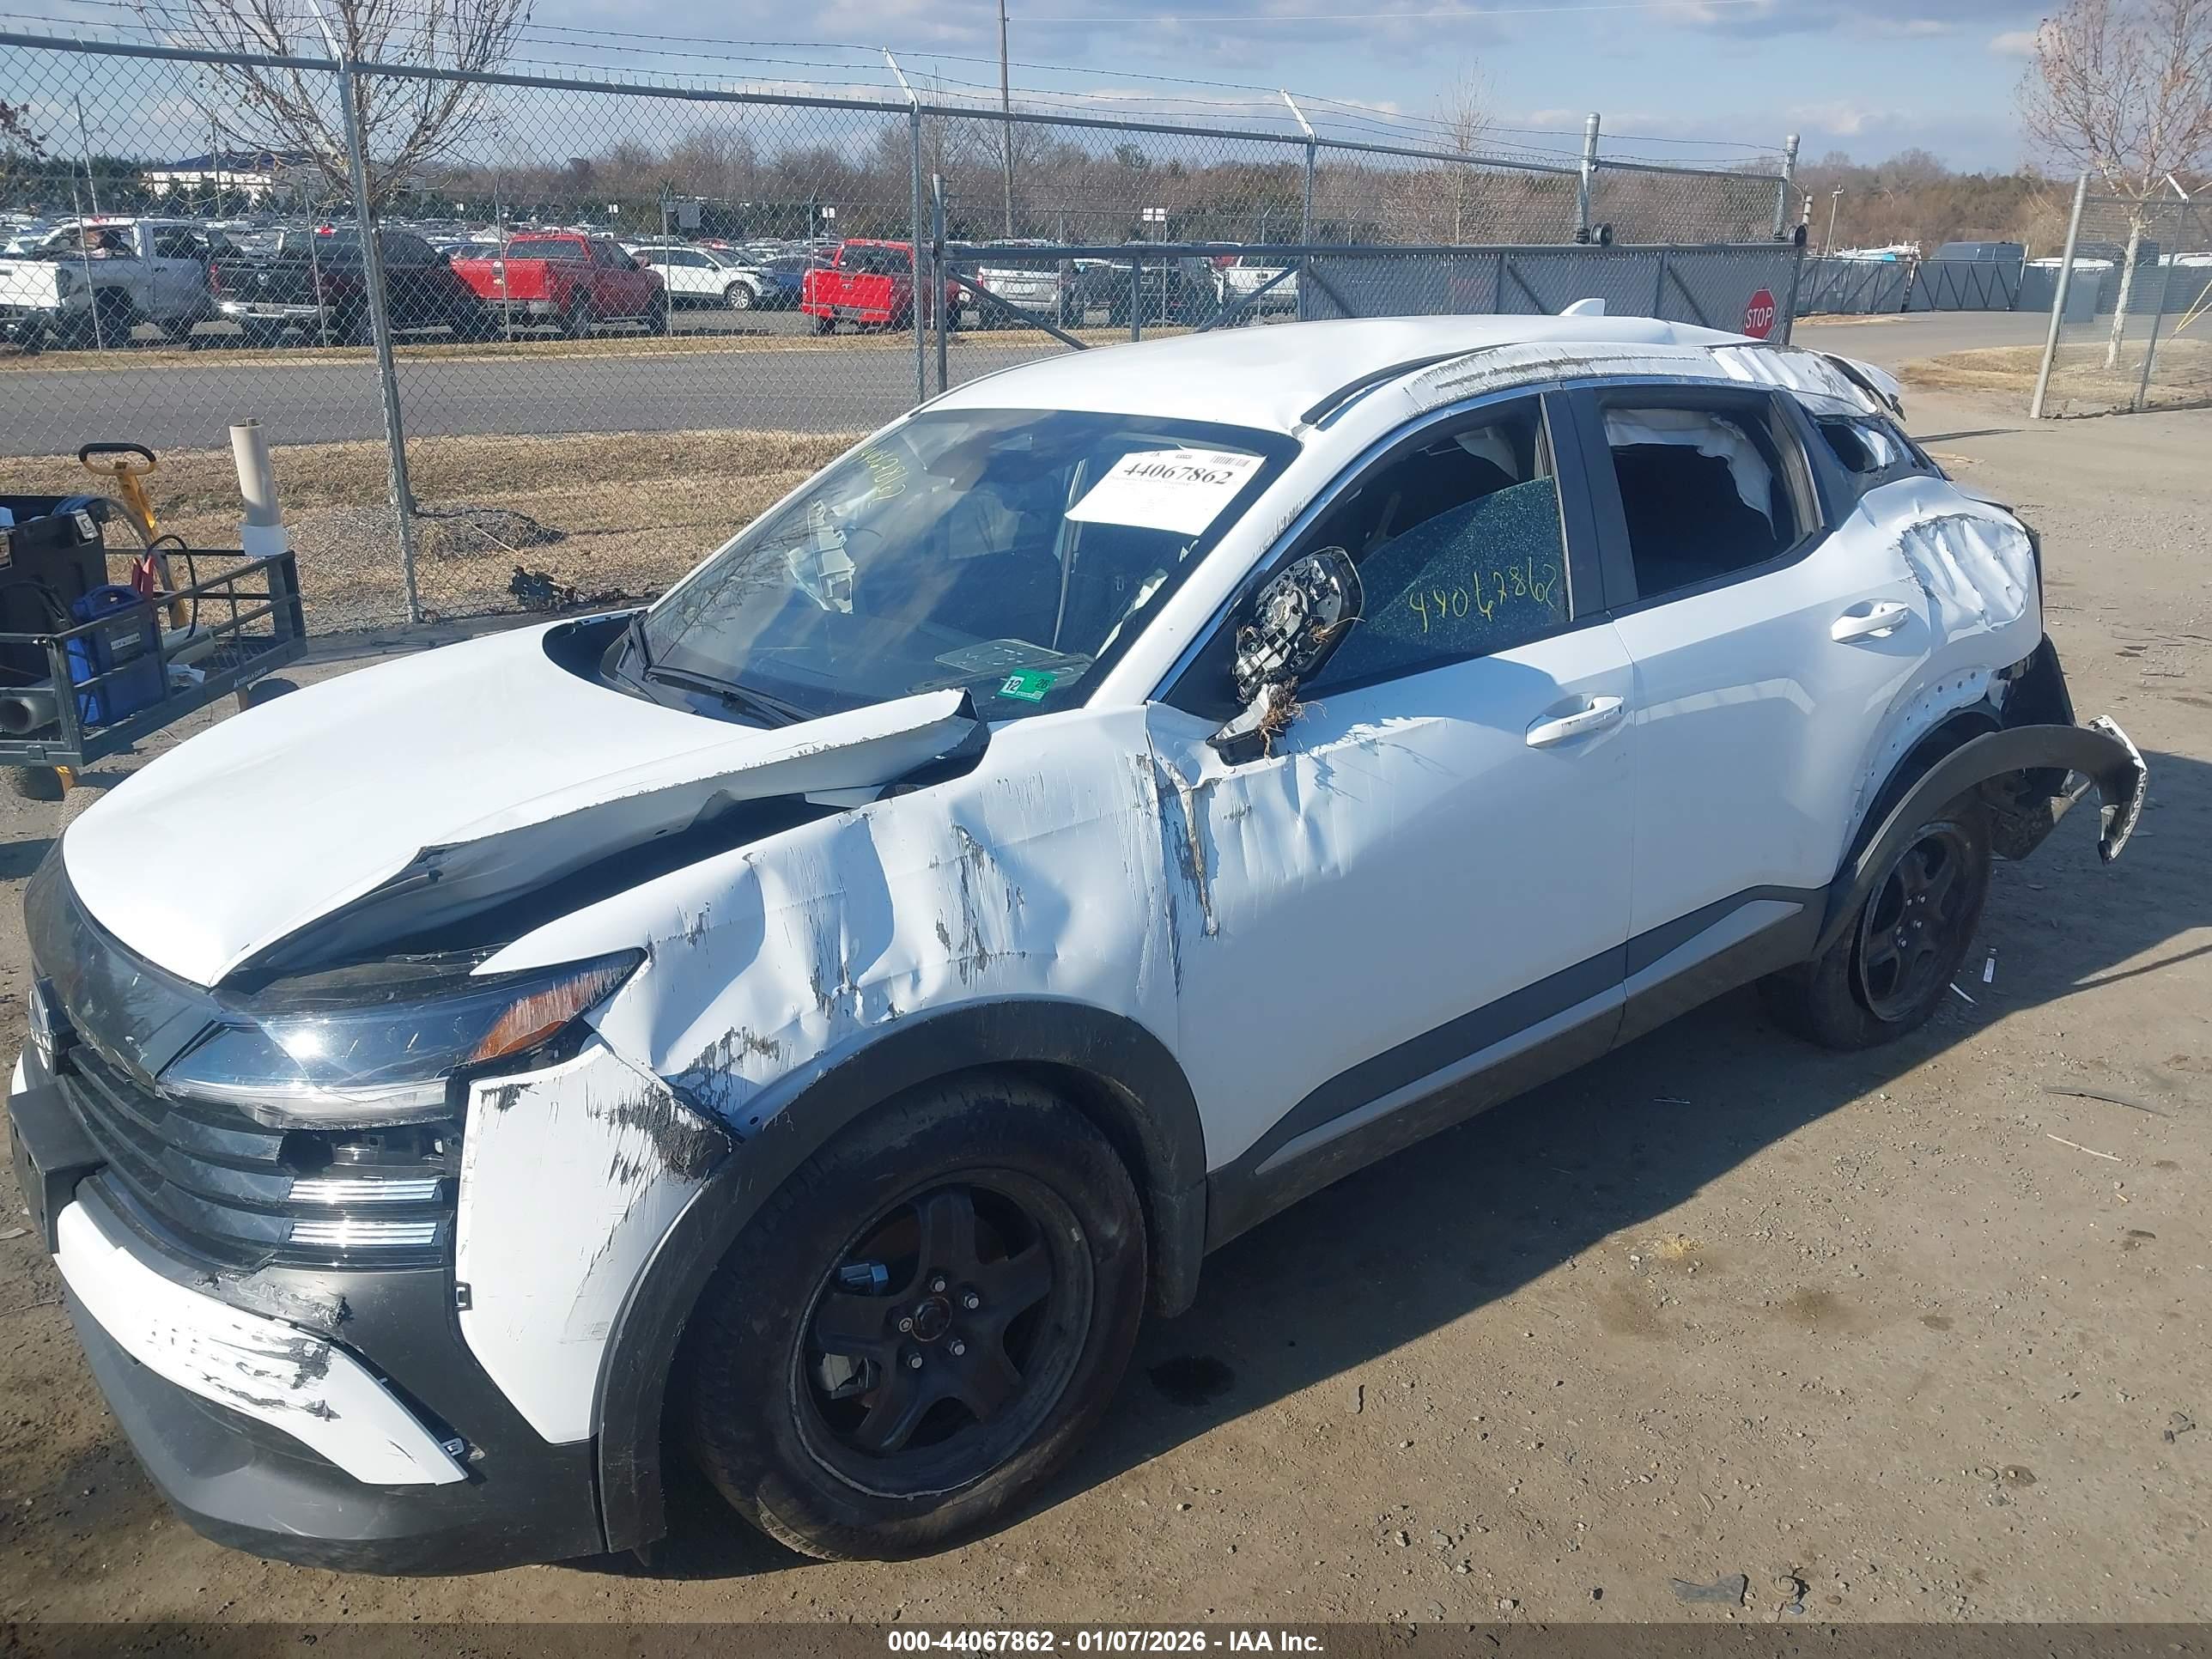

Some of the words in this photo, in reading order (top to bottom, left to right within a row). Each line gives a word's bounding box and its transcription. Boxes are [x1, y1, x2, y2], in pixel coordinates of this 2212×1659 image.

[1746, 307, 1773, 329] STOP
[1123, 463, 1233, 485] 44067862
[1409, 556, 1557, 633] 44067862
[1006, 679, 1022, 691] 12
